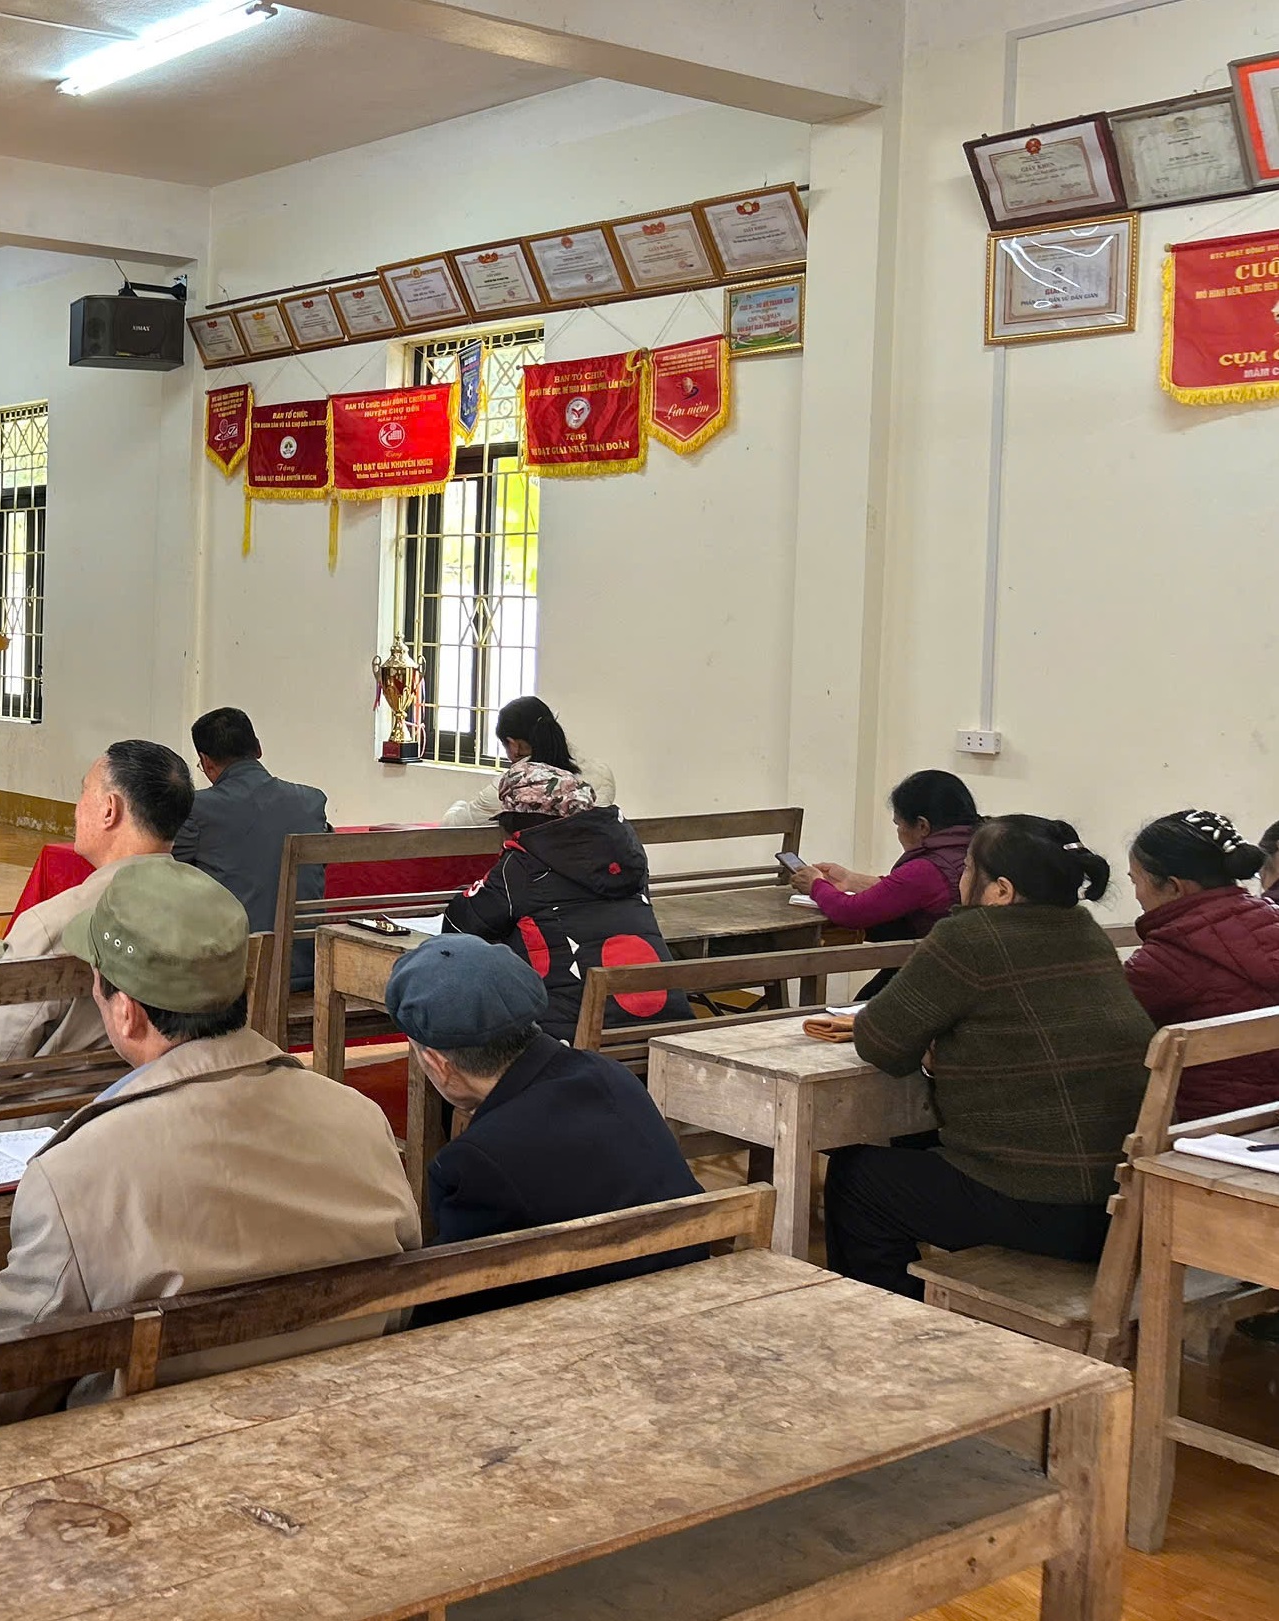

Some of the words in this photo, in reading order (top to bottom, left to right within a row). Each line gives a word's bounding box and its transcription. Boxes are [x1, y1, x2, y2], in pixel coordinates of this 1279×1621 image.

[1219, 350, 1267, 367] CỤM
[565, 432, 587, 443] Tặng
[606, 439, 630, 450] ĐOÀN
